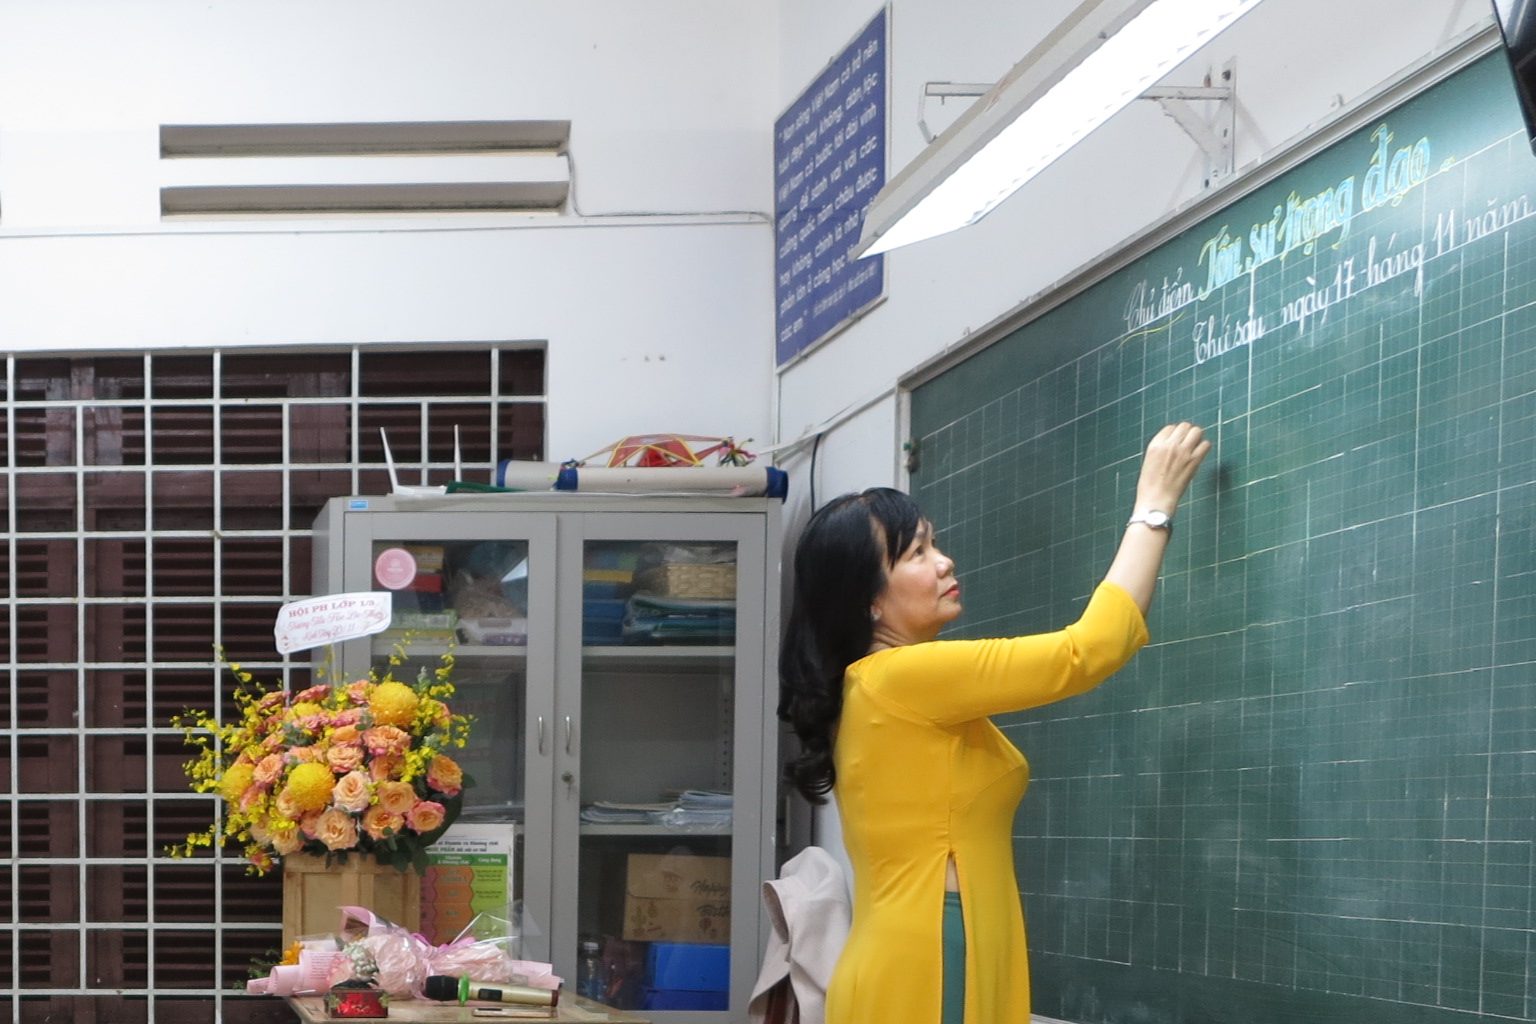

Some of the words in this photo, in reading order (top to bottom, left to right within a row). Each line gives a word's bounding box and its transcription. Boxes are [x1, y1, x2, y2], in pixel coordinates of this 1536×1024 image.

[1192, 314, 1231, 365] Thứ
[1280, 275, 1331, 336] ngày
[1331, 256, 1357, 304] 17
[1432, 208, 1456, 257] 11
[1464, 194, 1533, 243] năm
[1197, 223, 1244, 302] Tôn
[1245, 203, 1282, 272] sư
[1277, 175, 1355, 261] trọng
[1362, 122, 1431, 213] đạo
[288, 607, 310, 618] HỘI
[312, 604, 328, 613] PH
[332, 600, 357, 610] LỚP
